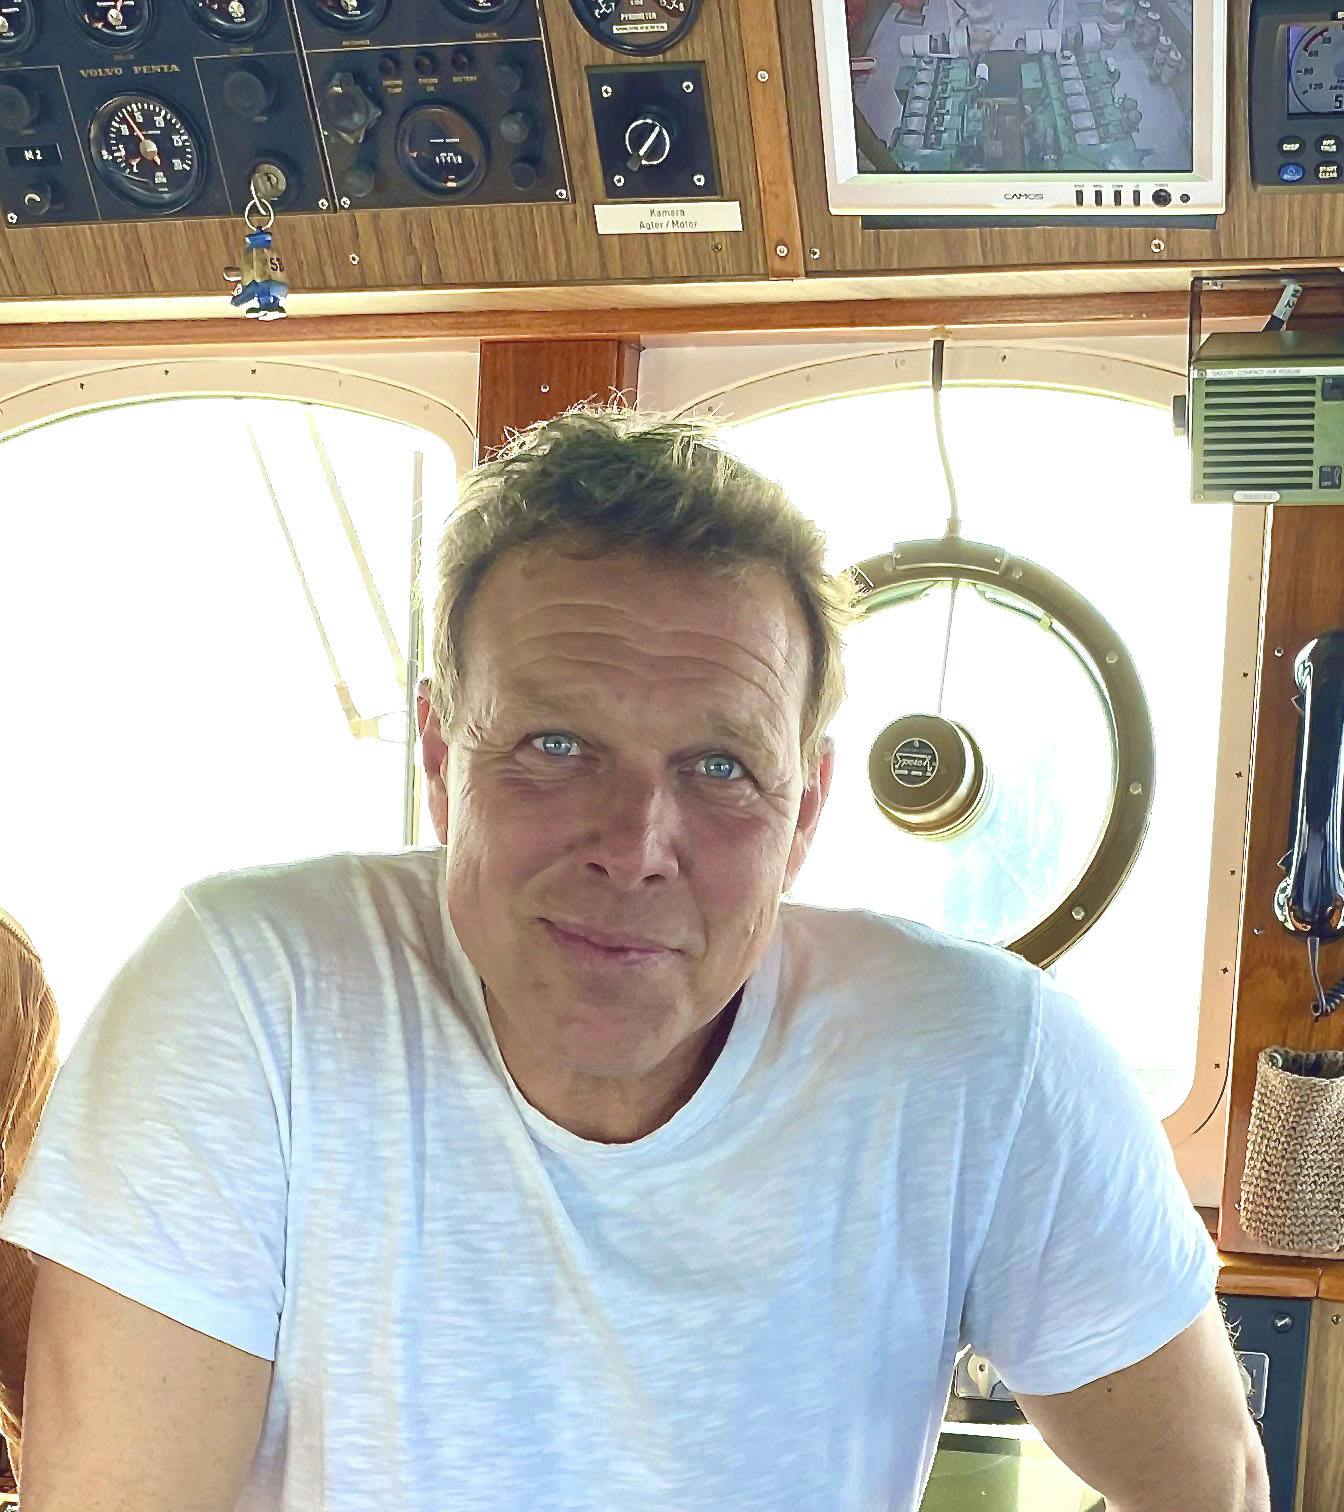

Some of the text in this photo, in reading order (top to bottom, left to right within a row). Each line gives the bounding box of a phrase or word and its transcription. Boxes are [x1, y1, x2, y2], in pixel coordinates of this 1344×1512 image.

[80, 64, 180, 77] VOLVO PENTA
[1003, 192, 1044, 200] CAMOS
[649, 208, 685, 217] Kamera
[671, 219, 697, 229] Motor
